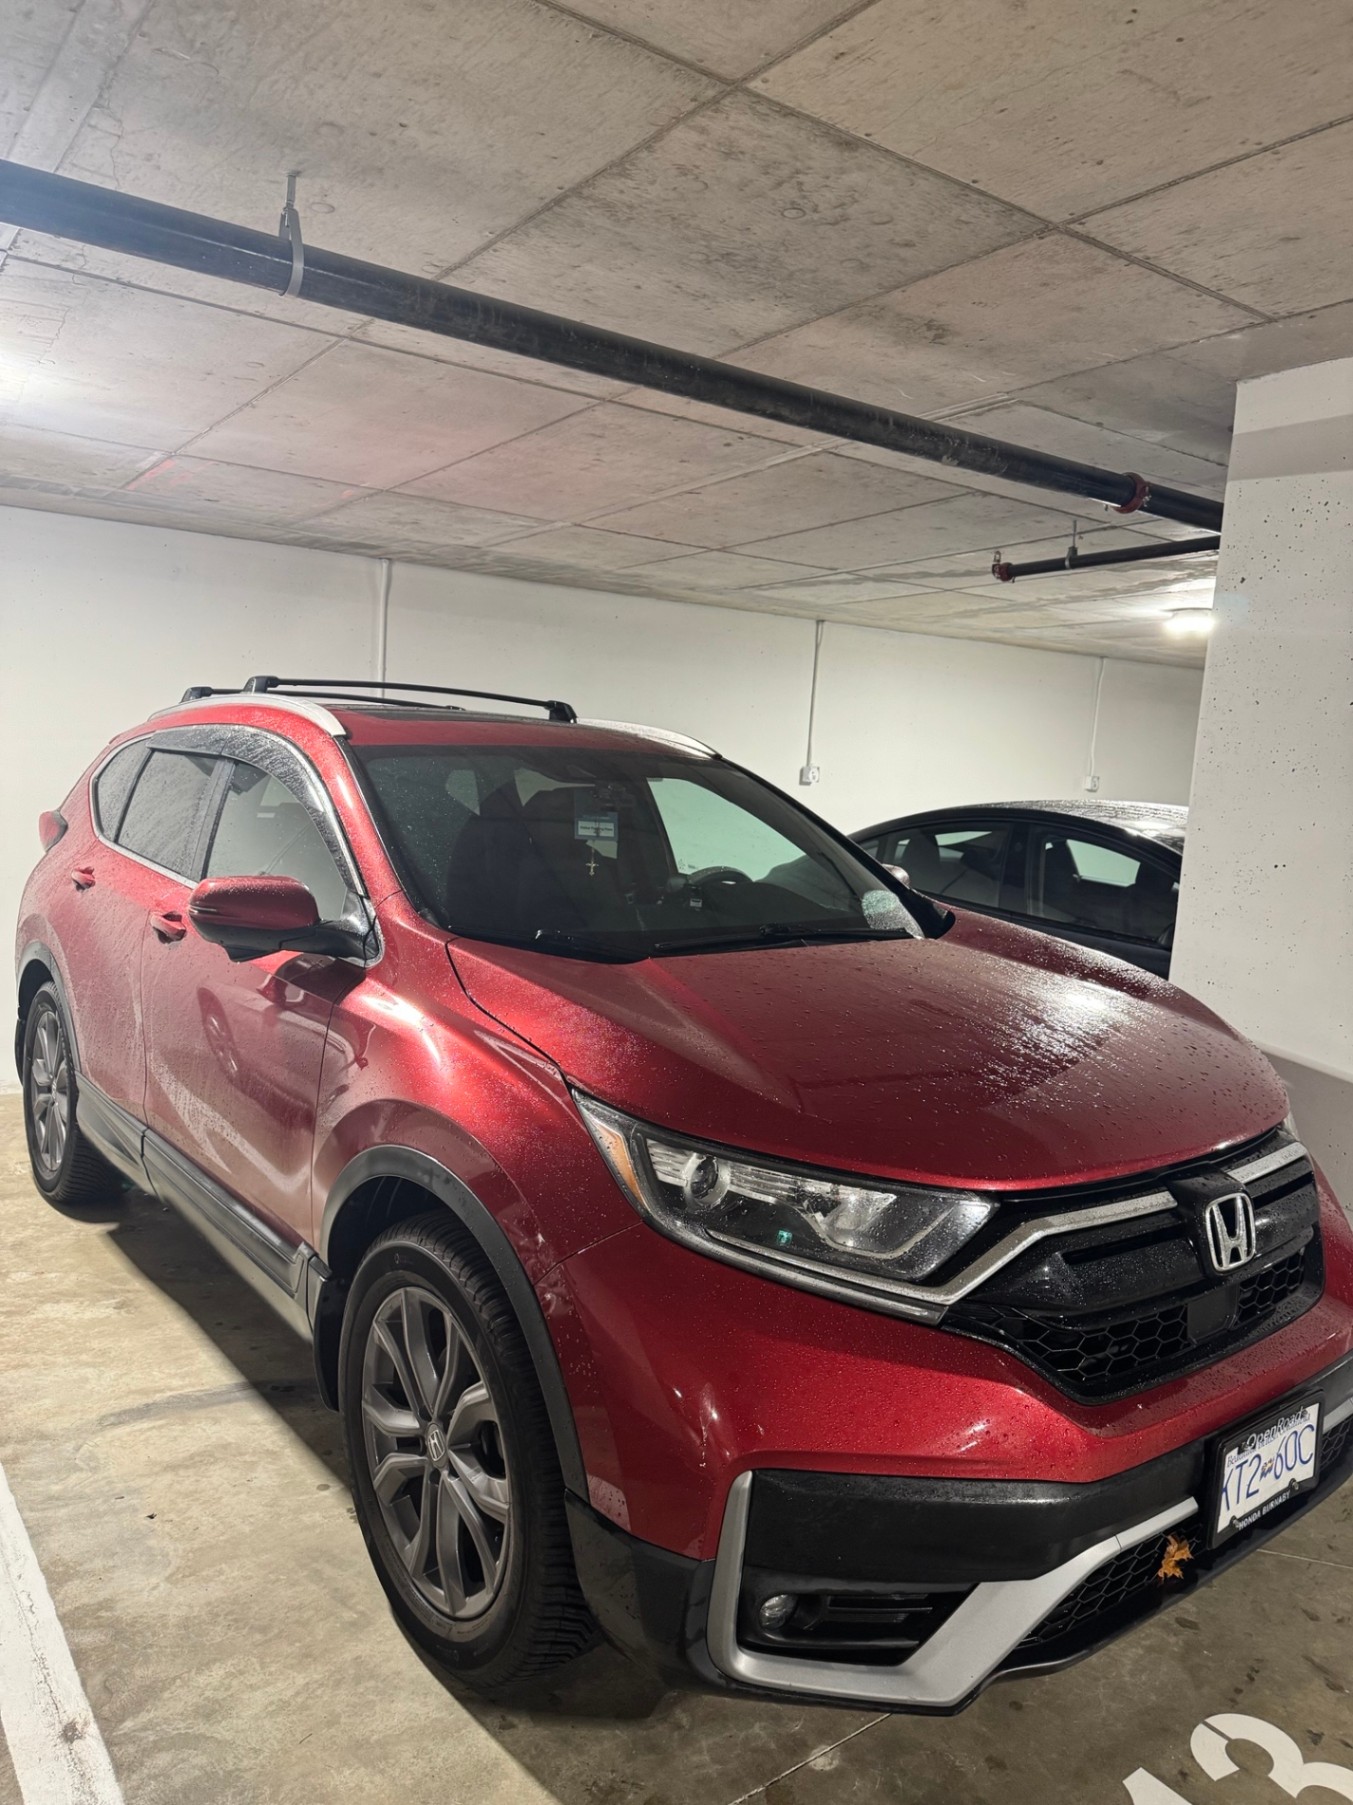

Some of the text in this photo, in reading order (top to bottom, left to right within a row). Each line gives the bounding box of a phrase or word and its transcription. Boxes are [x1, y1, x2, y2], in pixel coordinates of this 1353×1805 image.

[1246, 1406, 1304, 1448] OpenRoad
[1238, 1490, 1291, 1530] HONDA BURNABY
